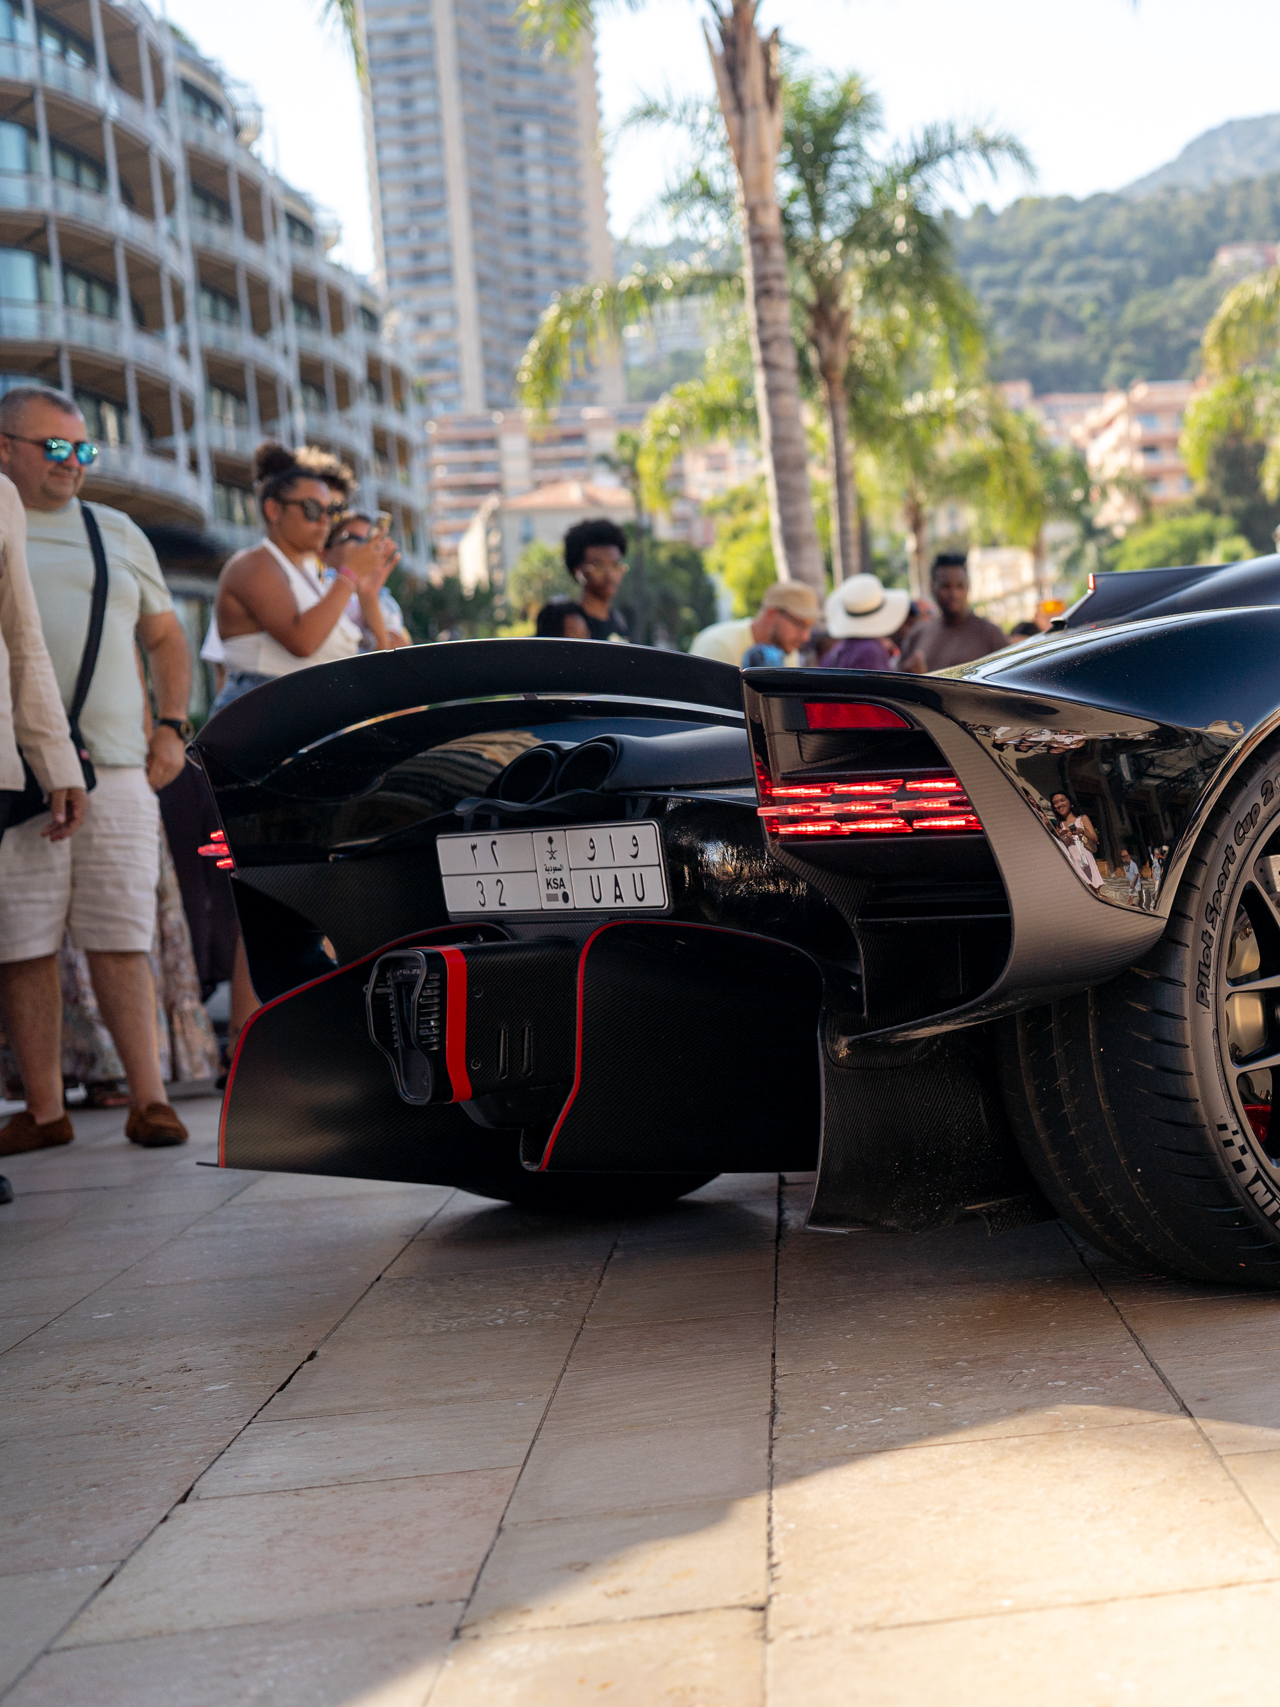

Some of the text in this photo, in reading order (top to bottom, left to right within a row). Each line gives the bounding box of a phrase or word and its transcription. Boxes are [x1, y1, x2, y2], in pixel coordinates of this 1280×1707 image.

[545, 877, 566, 890] KSA
[1196, 780, 1274, 1009] Pilot Sport Cup 2
